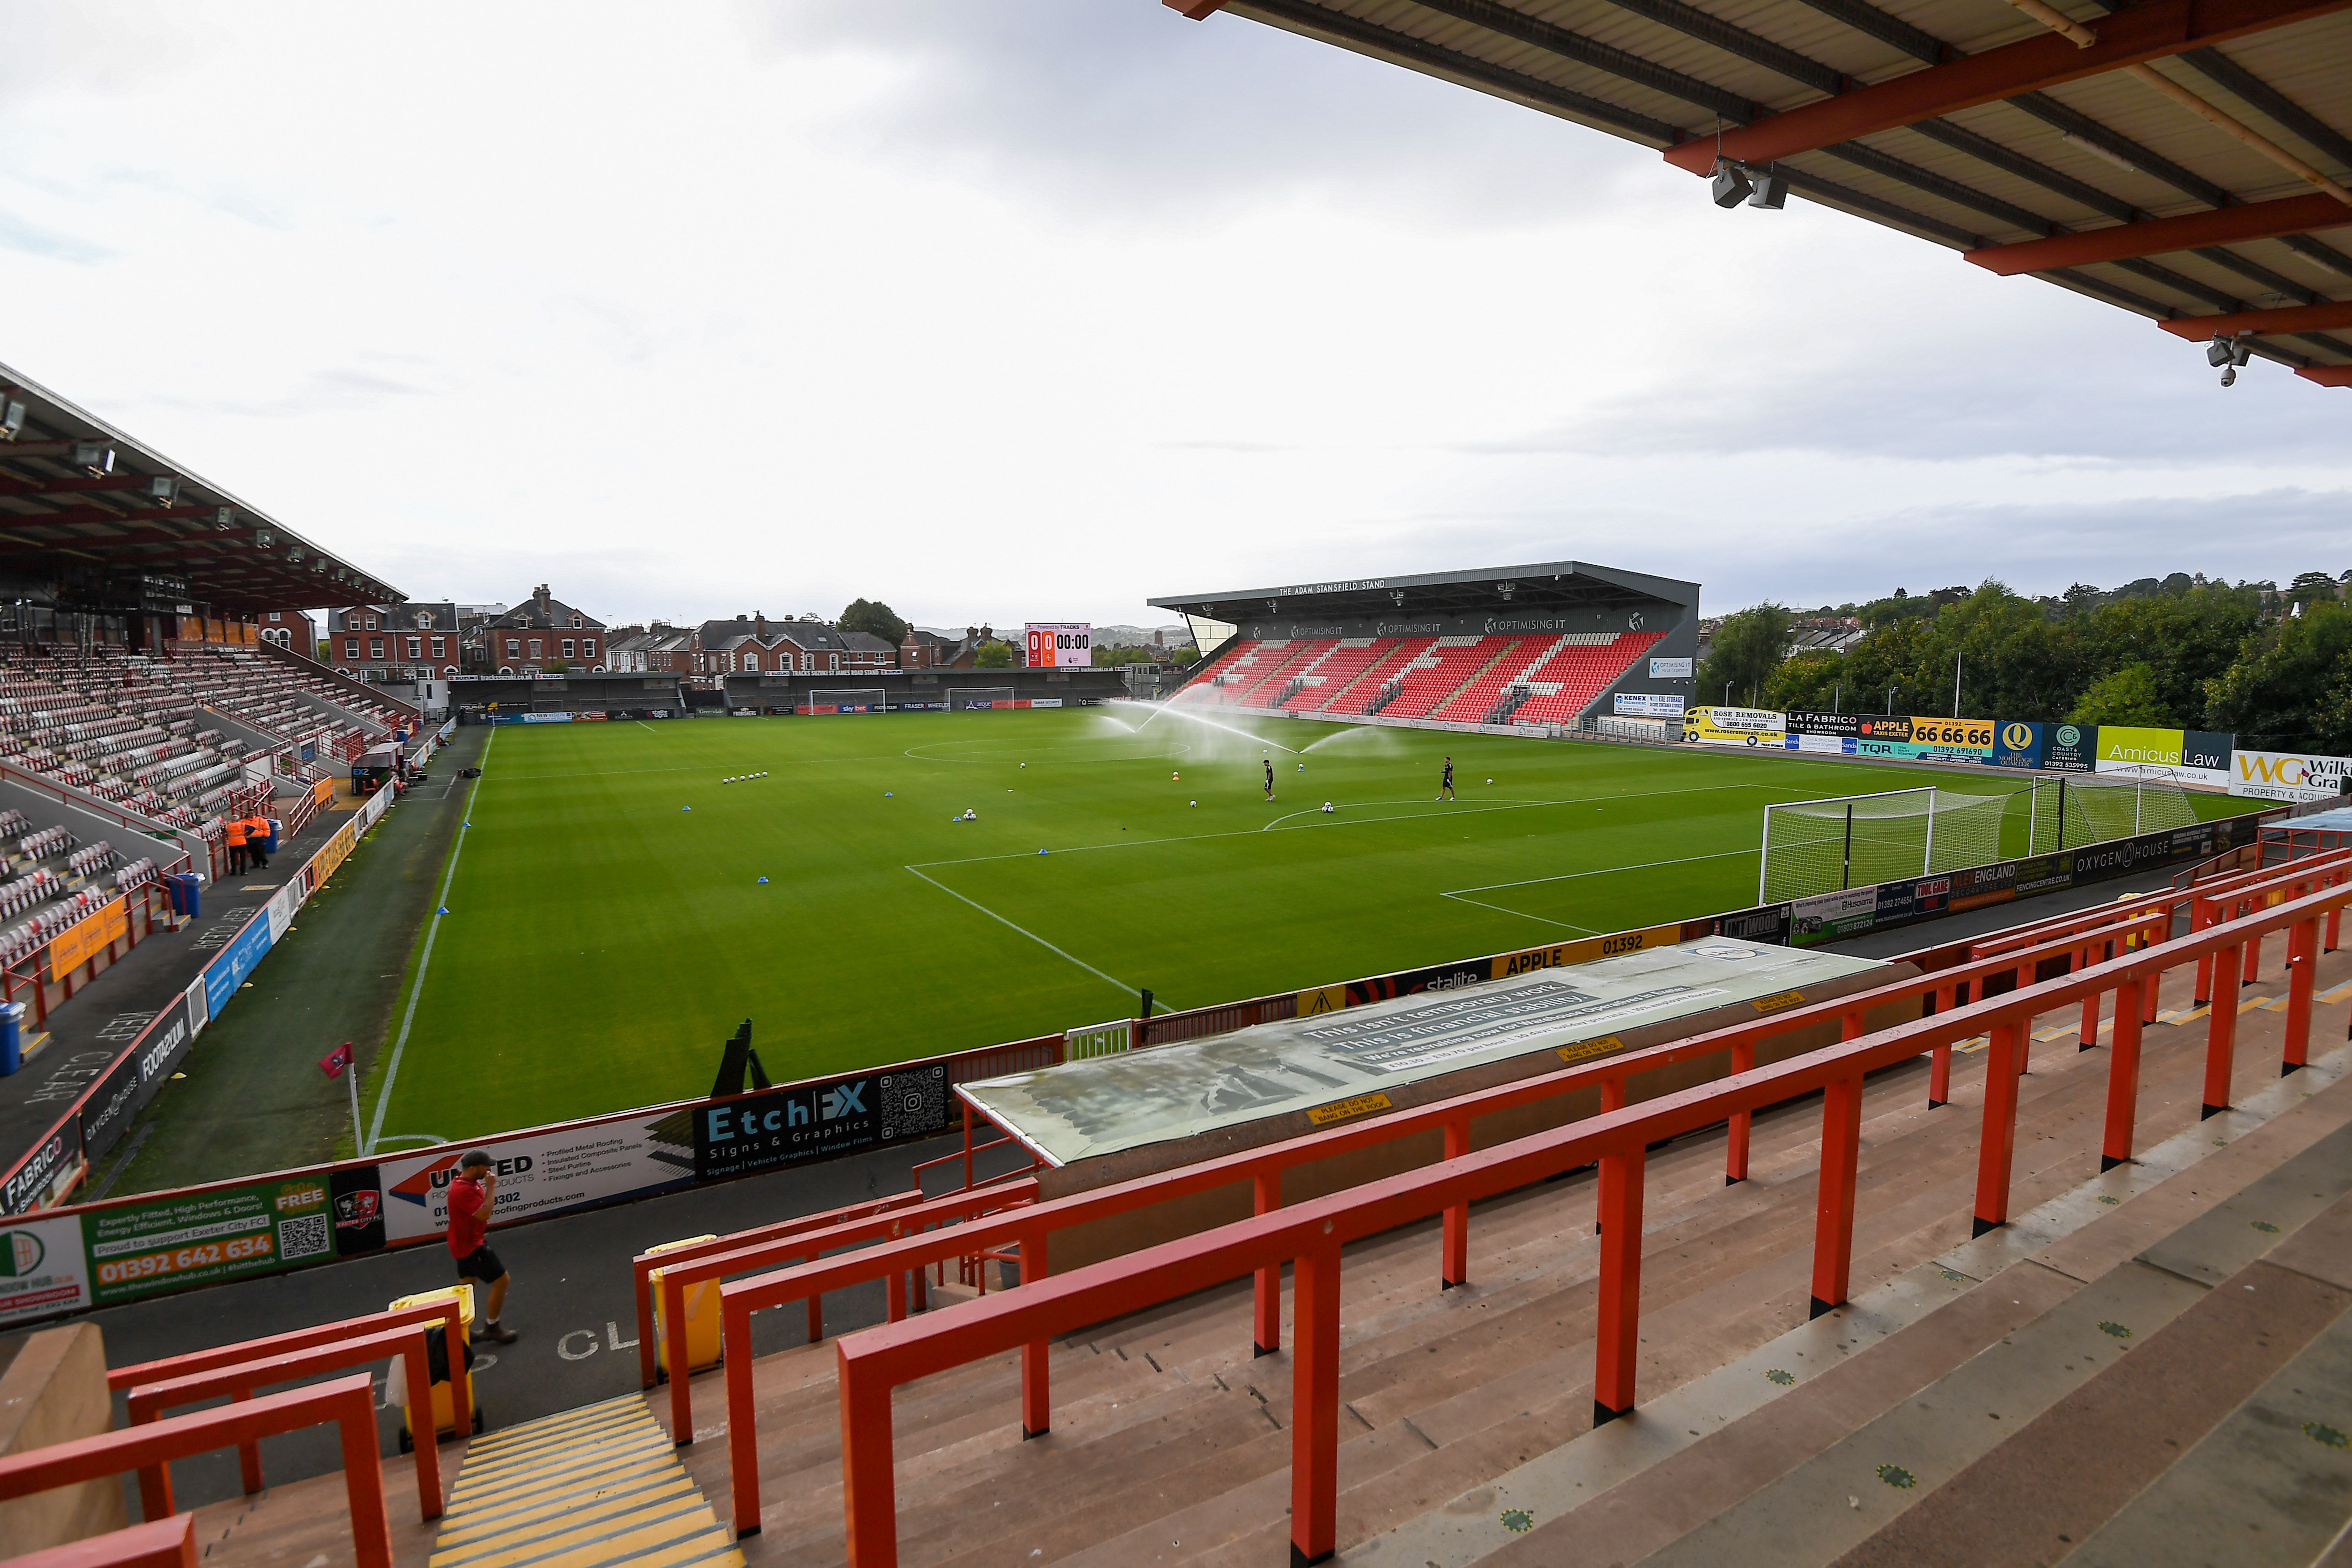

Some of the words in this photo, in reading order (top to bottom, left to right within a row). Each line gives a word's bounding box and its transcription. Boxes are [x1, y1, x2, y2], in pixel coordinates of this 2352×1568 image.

[1295, 586, 1313, 594] ADAM
[1317, 582, 1357, 593] STANSFIELD
[1362, 580, 1385, 589] STAND
[1388, 624, 1430, 633] OPTIMISING
[1433, 623, 1440, 632] IT
[1500, 620, 1552, 630] OPTIMISING
[1556, 620, 1565, 629] IT
[1031, 635, 1038, 650] 0
[1057, 634, 1089, 649] 00:00
[1788, 713, 1803, 721] LA
[1806, 713, 1857, 724] FABRICO
[1873, 721, 1909, 732] APPLE
[1705, 728, 1778, 737] www.roseremovals.co.uk
[1860, 743, 1892, 754] TQR
[1933, 746, 1954, 754] 01392
[1956, 747, 1982, 755] 691690
[2109, 744, 2179, 763] Amicus
[2184, 749, 2219, 767] Law
[2117, 766, 2208, 780] www.amicuslaw.co.uk
[2238, 755, 2304, 785] WG
[2243, 788, 2286, 798] PROPERTY
[2077, 852, 2122, 871] OXYGEN
[2134, 841, 2168, 859] HOUSE
[1918, 884, 1932, 897] TOOL
[1933, 880, 1948, 894] CARE
[2016, 874, 2070, 892] FENCINGCENTRE.CO.UK
[1847, 897, 1873, 909] Husqvarna
[1878, 899, 1893, 910] 01392
[1894, 896, 1912, 907] 274654
[1749, 914, 1778, 934] WOOD
[1838, 923, 1853, 934] 01803
[1853, 919, 1873, 930] 872124
[1507, 949, 1562, 975] APPLE
[1603, 935, 1642, 955] 01392
[1427, 972, 1477, 991] stalite
[1303, 1026, 1358, 1039] This
[1356, 1016, 1409, 1030] isn't
[1406, 994, 1512, 1019] temporary
[1511, 983, 1566, 997] work.
[95, 1011, 159, 1040] KEEP
[1332, 1036, 1389, 1050] This
[1387, 1031, 1413, 1040] is
[1410, 1010, 1507, 1035] financial
[1504, 994, 1588, 1014] stability.
[142, 1018, 185, 1082] FOOTASYLUM
[24, 1051, 114, 1104] CLEAR
[1318, 1112, 1338, 1122] BANG
[1367, 1101, 1384, 1110] ROOF
[1320, 1104, 1348, 1114] PLEASE
[708, 1100, 808, 1142] Etch
[547, 1147, 574, 1157] Profiled
[575, 1143, 594, 1152] Metal
[596, 1138, 623, 1147] Roofing
[710, 1143, 760, 1158] Signs
[772, 1137, 780, 1146] &
[792, 1120, 869, 1143] Graphics
[548, 1154, 580, 1165] Insulated
[581, 1148, 618, 1159] Composite
[620, 1142, 642, 1151] Panels
[707, 1164, 740, 1176] Signage
[747, 1157, 777, 1167] Vehicle
[780, 1149, 814, 1162] Graphics
[821, 1141, 851, 1152] Window
[853, 1136, 873, 1145] Films
[6, 1136, 62, 1207] FABRICO
[549, 1172, 574, 1182] Fixings
[590, 1161, 632, 1173] Accessories
[277, 1189, 324, 1210] FREE
[98, 1226, 132, 1238] Energy
[133, 1218, 176, 1230] Efficient,
[177, 1210, 222, 1222] Windows
[234, 1202, 263, 1213] Doors!
[99, 1214, 140, 1227] Expertly
[142, 1208, 173, 1219] Fitted,
[175, 1205, 196, 1214] High
[198, 1195, 259, 1209] Performance,
[98, 1242, 131, 1254] Proud
[148, 1231, 189, 1246] support
[192, 1225, 226, 1236] Exeter
[228, 1221, 248, 1231] City
[251, 1217, 267, 1227] FC!
[101, 1254, 171, 1282] 01392
[177, 1245, 221, 1268] 642
[226, 1236, 270, 1258] 634
[100, 1268, 221, 1296] www.thewindowhub.co.uk
[229, 1257, 275, 1271] #hitthehub
